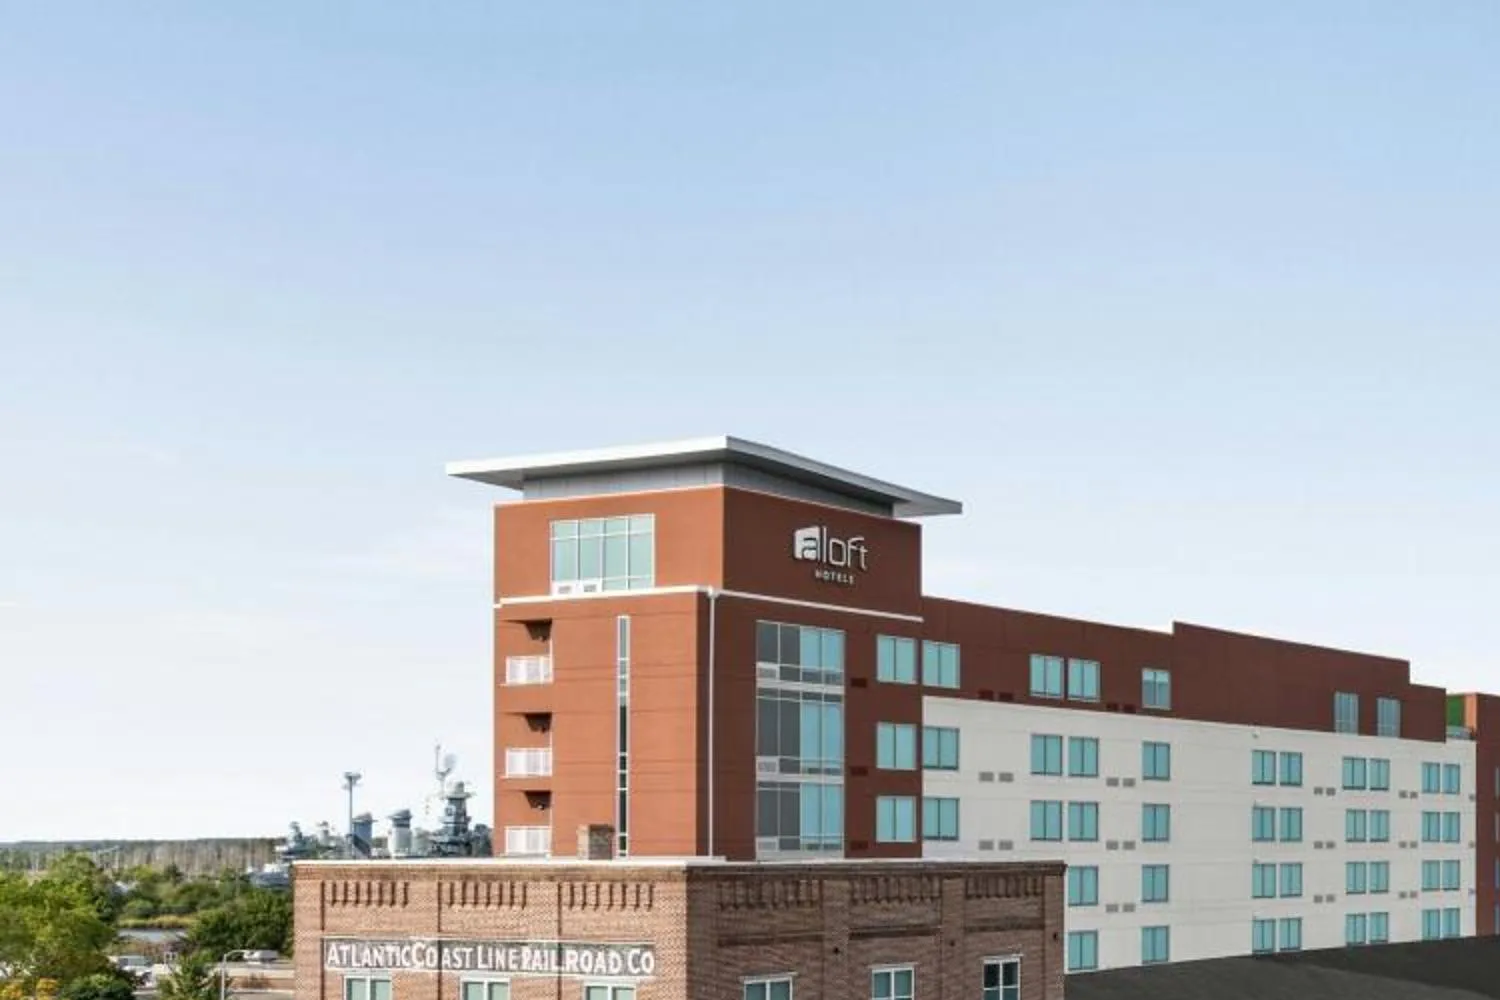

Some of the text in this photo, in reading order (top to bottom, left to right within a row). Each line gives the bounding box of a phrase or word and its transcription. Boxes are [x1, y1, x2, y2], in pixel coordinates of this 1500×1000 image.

[794, 526, 868, 571] aloft
[815, 569, 854, 585] HOTELS
[327, 942, 411, 968] ATLANTIC
[411, 941, 473, 969] COAST
[476, 944, 519, 971] LINE
[627, 947, 655, 974] CO
